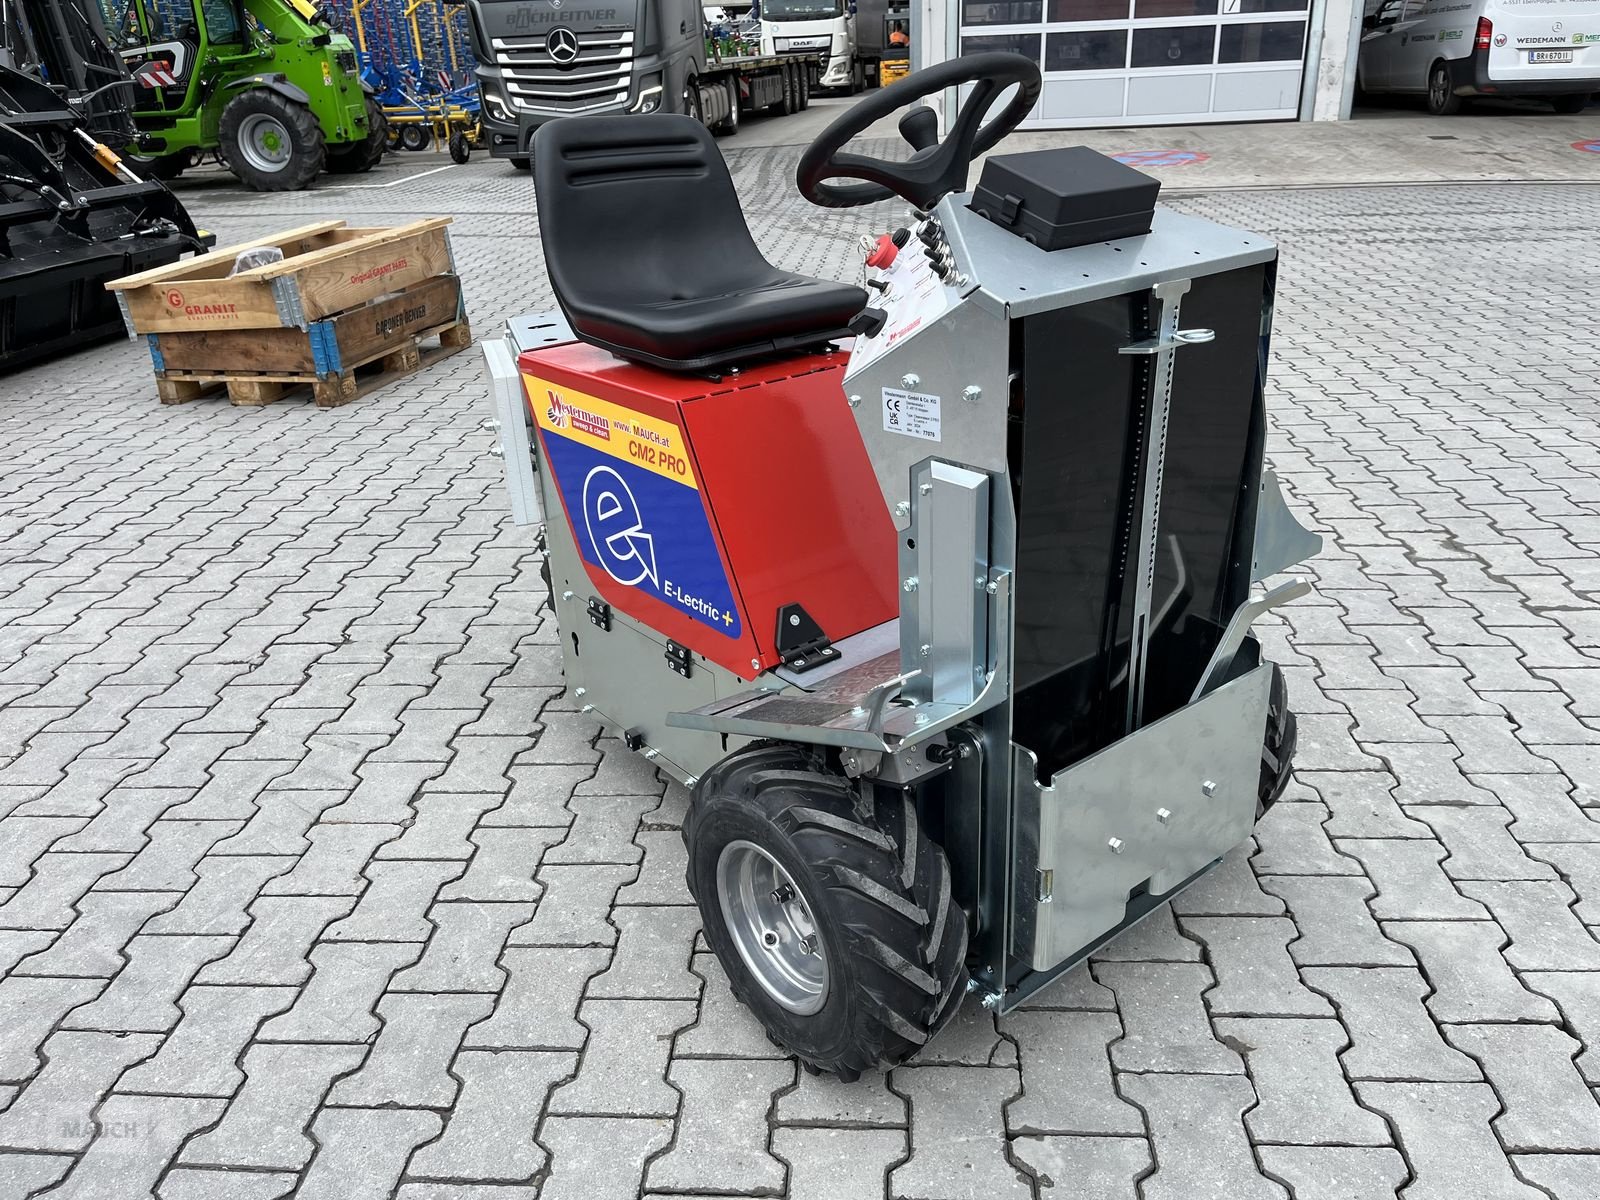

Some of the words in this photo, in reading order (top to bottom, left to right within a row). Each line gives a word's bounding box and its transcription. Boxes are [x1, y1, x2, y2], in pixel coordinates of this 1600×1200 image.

[1517, 36, 1566, 44] WEIDEMANN
[350, 269, 373, 284] Original
[372, 263, 392, 278] GRANIT
[392, 259, 407, 271] PARTS
[185, 304, 235, 315] GRANIT
[404, 305, 426, 324] DENVER
[548, 390, 609, 429] Westermann
[572, 420, 588, 431] sweep
[628, 440, 656, 464] CM2
[659, 451, 687, 476] PRO
[664, 580, 719, 621] E-Lectric
